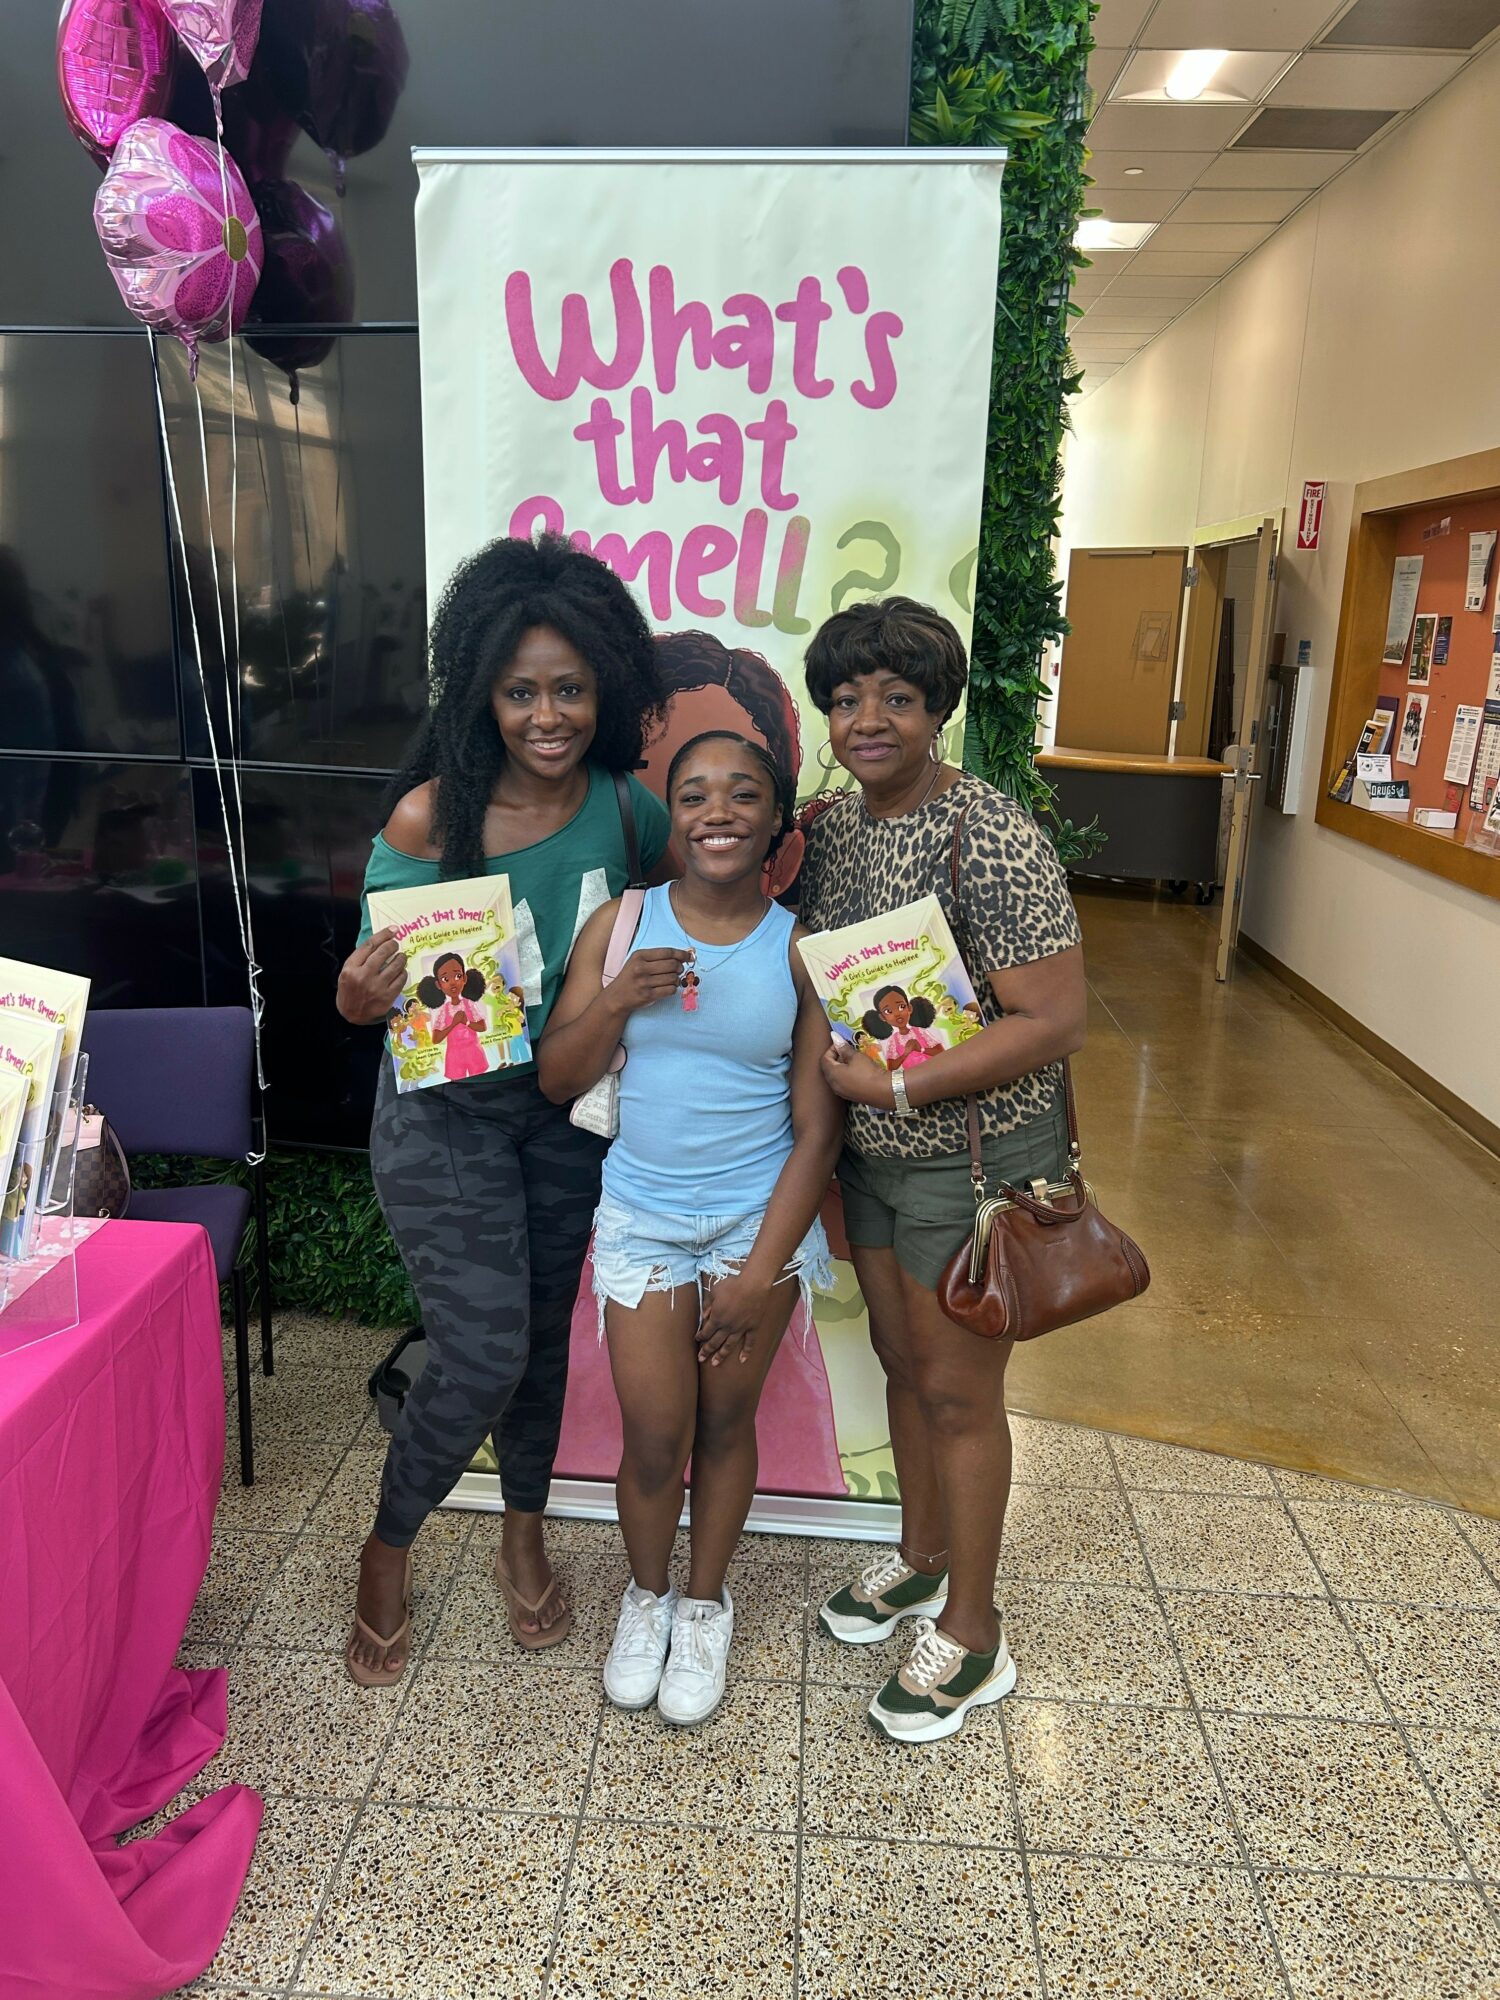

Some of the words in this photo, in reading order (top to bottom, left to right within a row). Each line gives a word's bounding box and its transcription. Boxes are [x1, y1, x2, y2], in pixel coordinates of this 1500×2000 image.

[504, 258, 904, 410] What's
[573, 386, 800, 511] that
[1306, 488, 1322, 498] FIRE
[1306, 500, 1314, 542] EXTINGUISHER
[1371, 784, 1396, 796] DRUGS
[395, 915, 430, 941] What's
[431, 909, 455, 923] that
[458, 907, 495, 925] Smell?
[409, 936, 415, 944] A
[415, 933, 432, 943] Girl's
[433, 931, 451, 940] Guide
[459, 925, 483, 936] Hygiene
[825, 954, 860, 981] What's
[860, 944, 885, 960] that
[887, 935, 929, 952] Smell?
[849, 970, 866, 981] Girl's
[866, 966, 884, 976] Guide
[885, 962, 893, 971] to
[893, 952, 919, 967] Hygiene
[18, 993, 36, 1011] that
